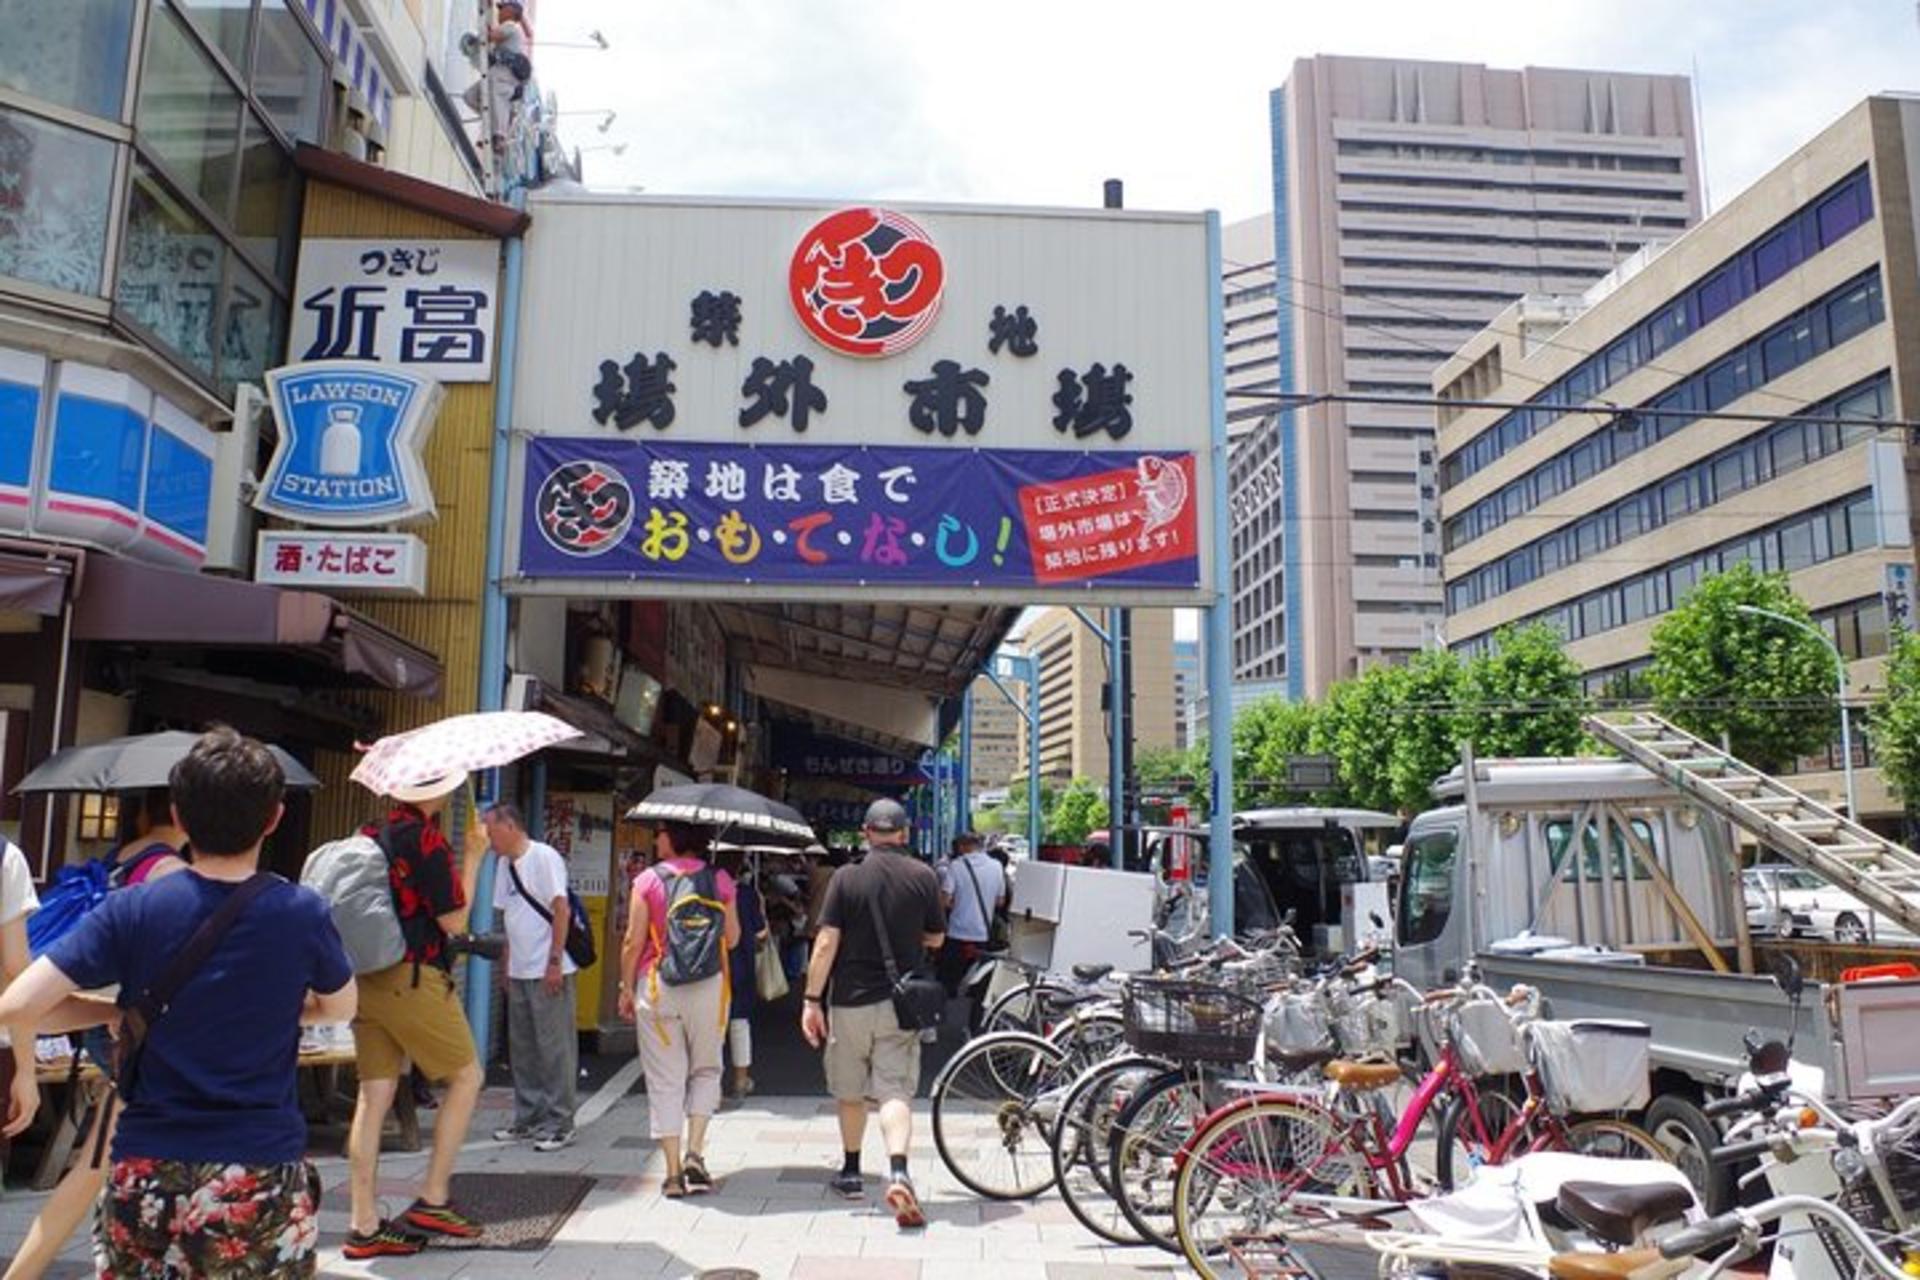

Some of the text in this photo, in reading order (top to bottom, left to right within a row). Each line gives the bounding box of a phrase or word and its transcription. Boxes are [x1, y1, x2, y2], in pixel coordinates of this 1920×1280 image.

[360, 247, 441, 276] つきじ
[301, 285, 488, 363] 近富
[291, 382, 402, 407] LAWSON
[282, 473, 395, 498] STATION
